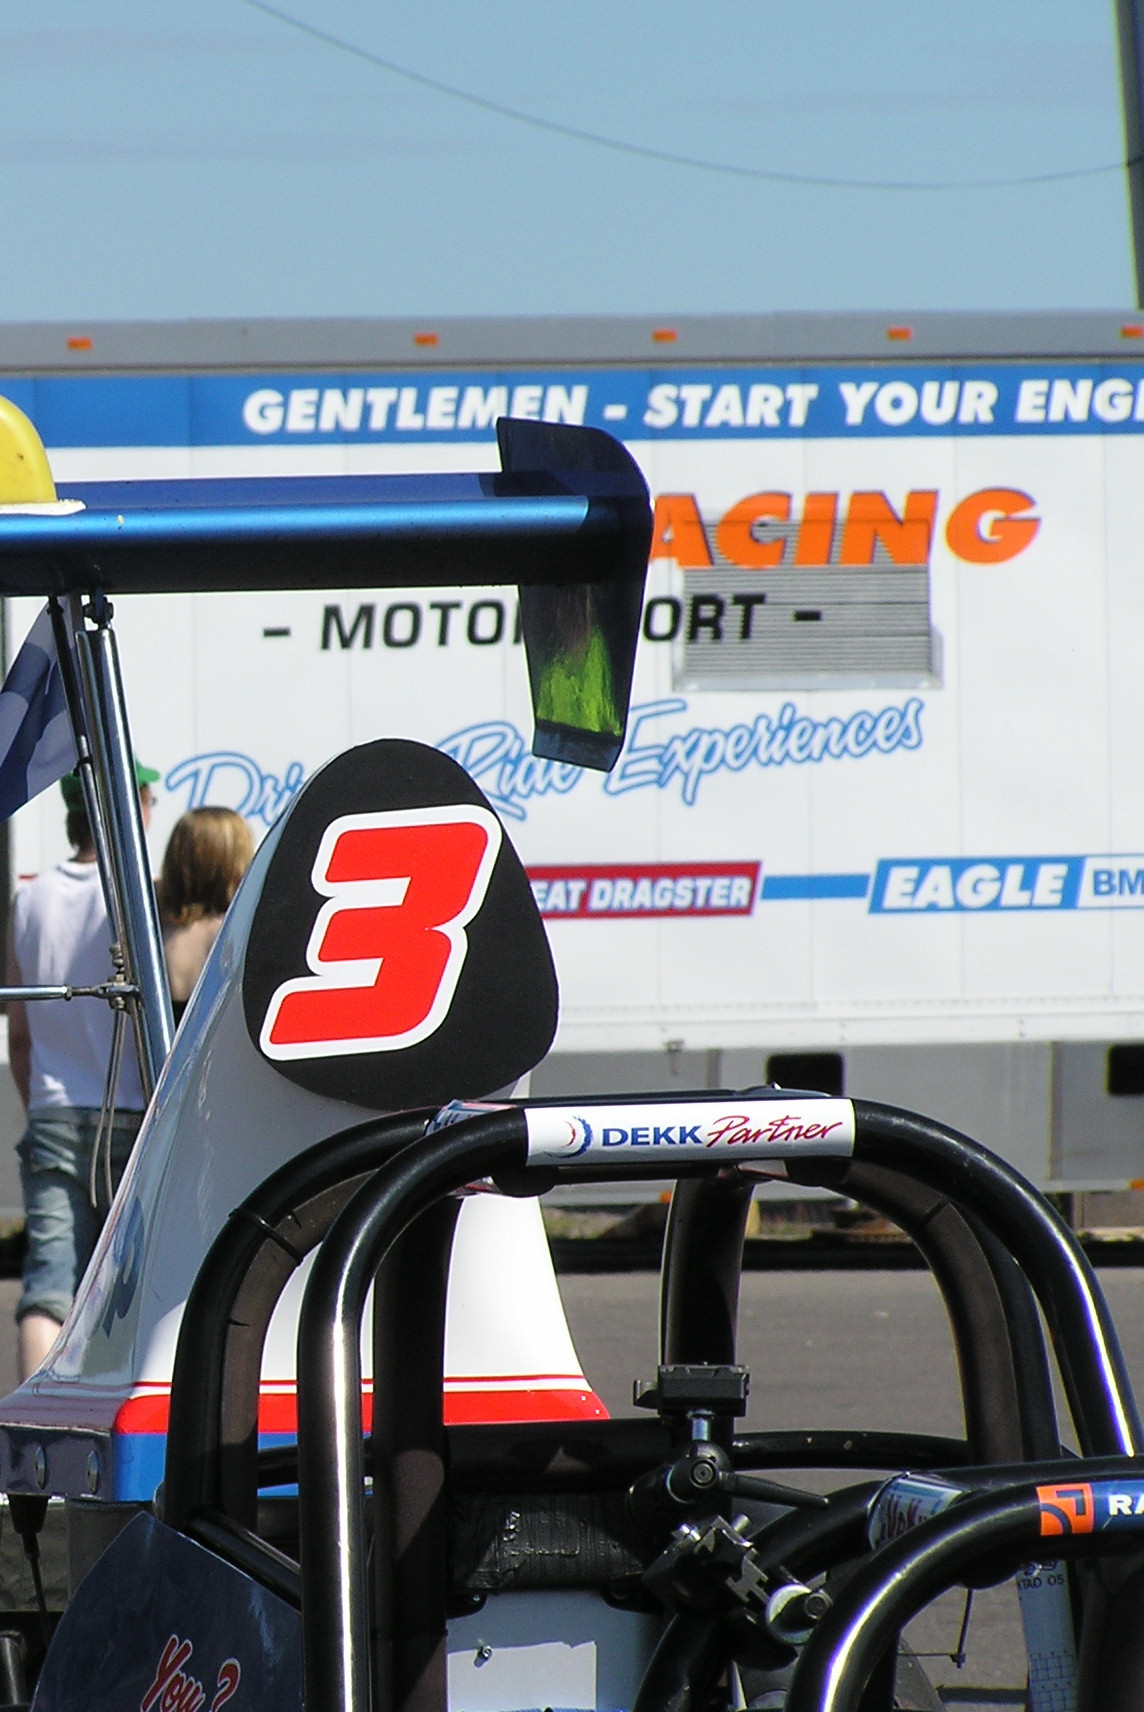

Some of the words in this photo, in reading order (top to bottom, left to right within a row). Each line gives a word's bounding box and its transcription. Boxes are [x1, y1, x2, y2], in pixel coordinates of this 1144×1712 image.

[243, 384, 588, 434] GENTLEMEN
[643, 382, 819, 429] START
[839, 380, 999, 427] YOUR
[650, 486, 1042, 569] ACING
[604, 697, 925, 806] Experiences
[530, 878, 586, 912] EAT
[587, 875, 752, 911] DRAGSTER
[881, 863, 1070, 911] EAGLE
[259, 803, 503, 1062] 3
[601, 1126, 704, 1147] DEKK
[706, 1113, 843, 1149] Partner
